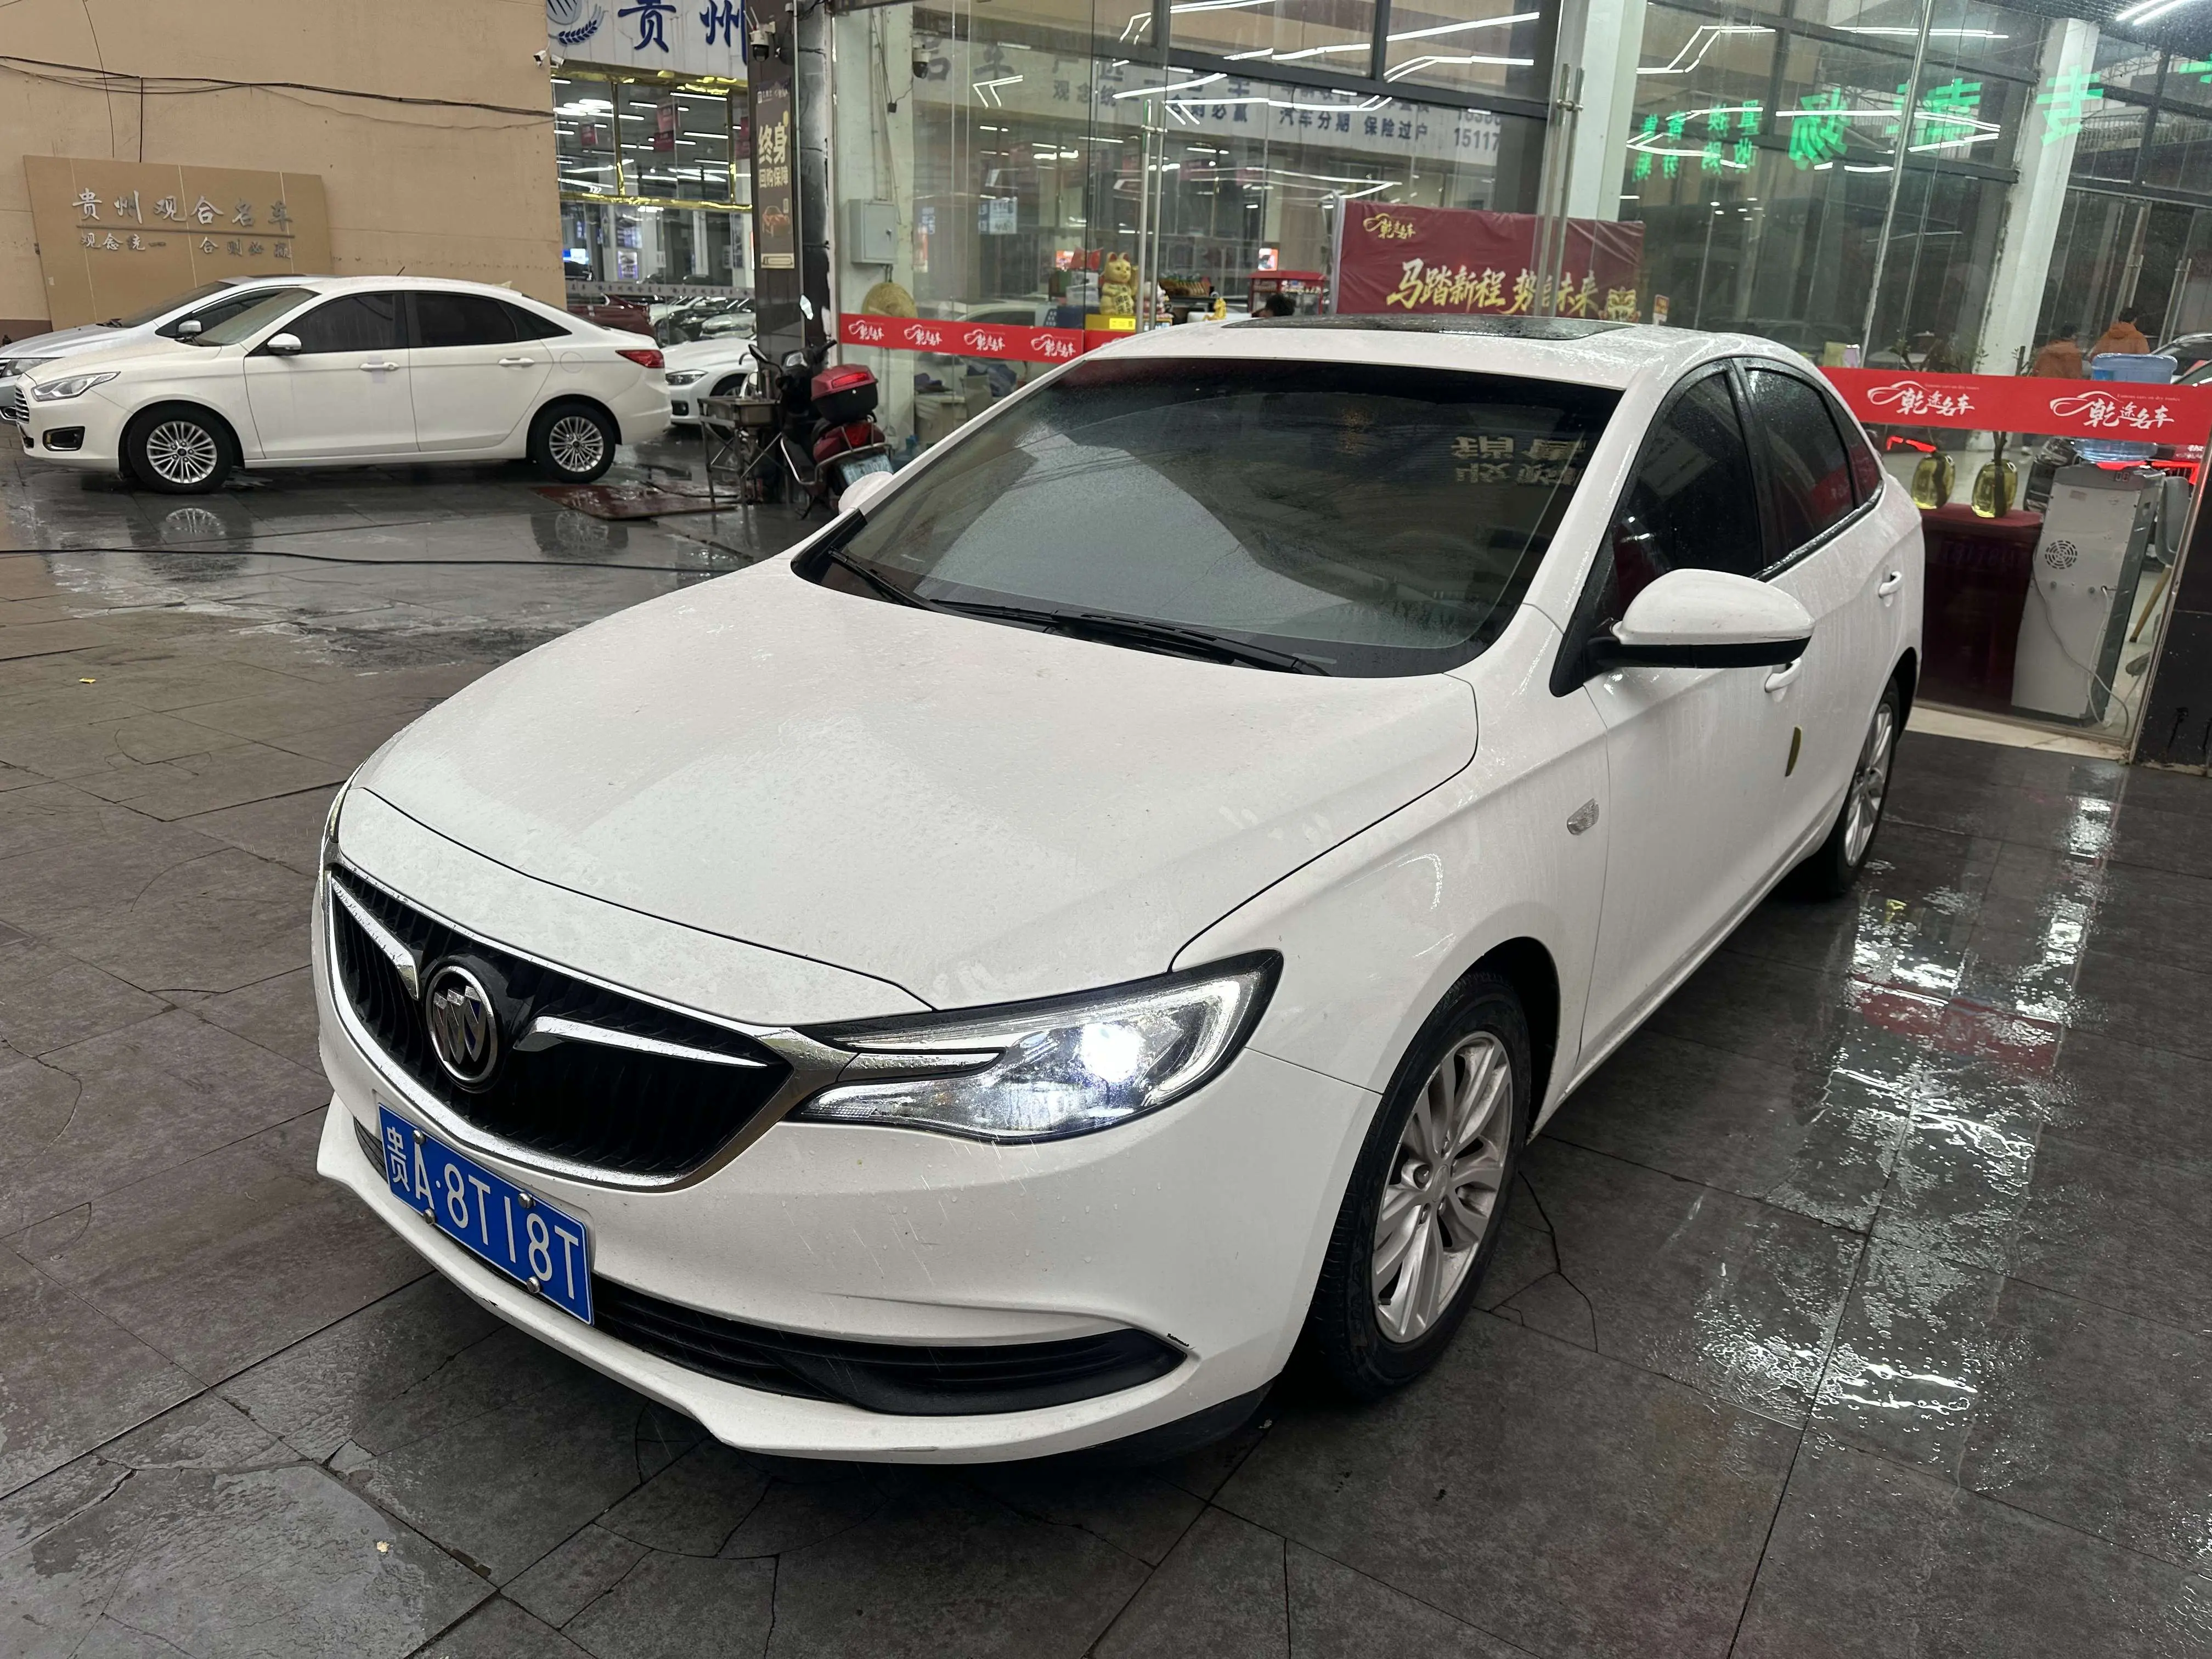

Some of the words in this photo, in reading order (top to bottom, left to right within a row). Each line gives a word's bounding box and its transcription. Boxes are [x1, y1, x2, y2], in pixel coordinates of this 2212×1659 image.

[618, 0, 747, 66] 贵州
[1279, 106, 1350, 133] 汽车分期
[1364, 115, 1428, 140] 保险过户
[758, 122, 787, 164] 终身
[72, 188, 292, 232] 贵州观合名车
[81, 233, 166, 251] 观念统一
[199, 236, 292, 259] 合则必赢
[1386, 257, 1506, 313] 马踏新程
[1896, 387, 1975, 416] 乾途名车
[2084, 398, 2175, 430] 乾途名车
